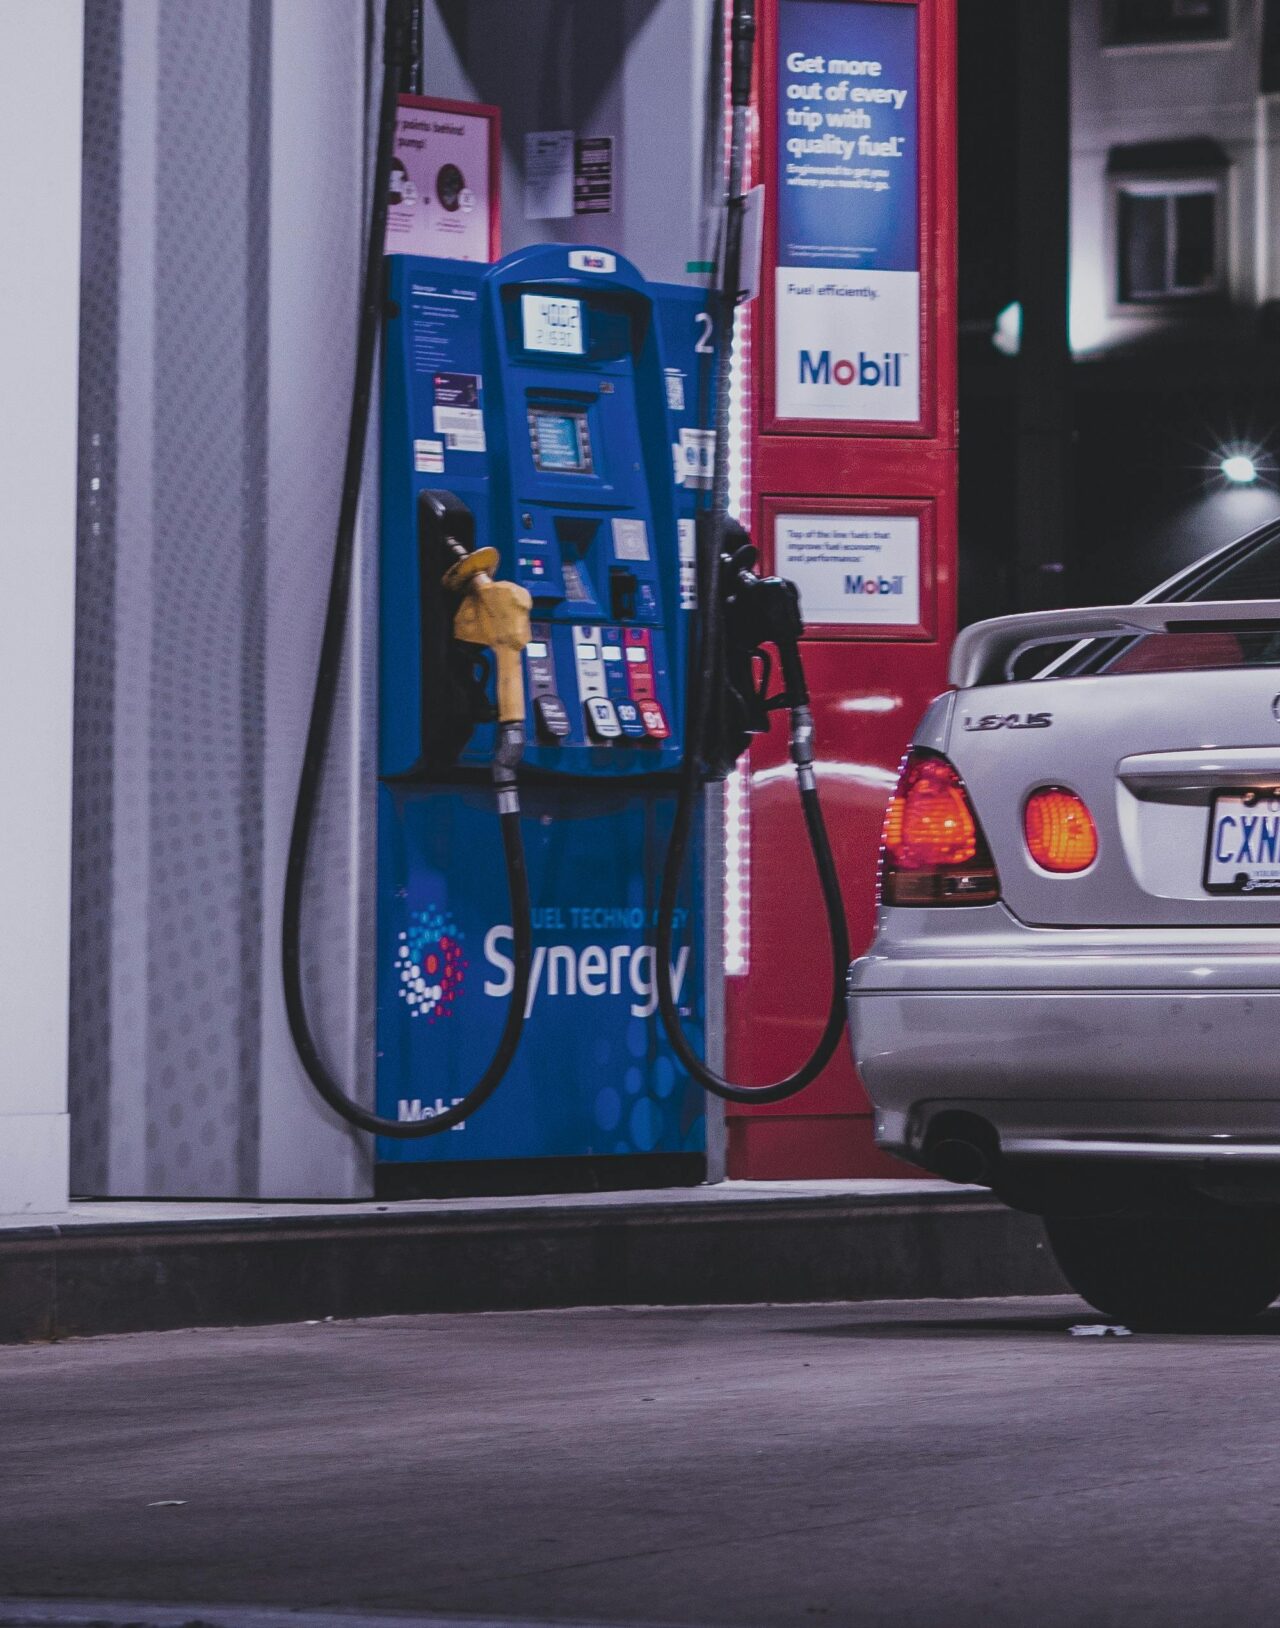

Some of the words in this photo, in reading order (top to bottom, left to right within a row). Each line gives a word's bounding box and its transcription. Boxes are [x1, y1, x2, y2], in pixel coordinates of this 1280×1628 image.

[786, 52, 826, 74] Get
[828, 58, 882, 76] more
[786, 82, 823, 100] out
[824, 80, 850, 101] of
[851, 86, 907, 110] every
[786, 106, 823, 132] trip
[825, 108, 872, 129] with
[786, 133, 856, 161] quality
[787, 283, 814, 296] Fuel
[694, 312, 715, 354] 2
[799, 350, 902, 387] Mobil
[787, 530, 803, 541] Top
[806, 530, 816, 539] of
[817, 530, 829, 539] the
[832, 529, 847, 539] line
[873, 530, 891, 540] that
[787, 542, 822, 552] improve
[824, 541, 840, 551] fuel
[787, 554, 803, 562] and
[844, 574, 904, 595] Mobil
[963, 712, 1054, 732] LEXUS
[530, 907, 566, 929] UEL
[482, 924, 691, 1019] Synergy
